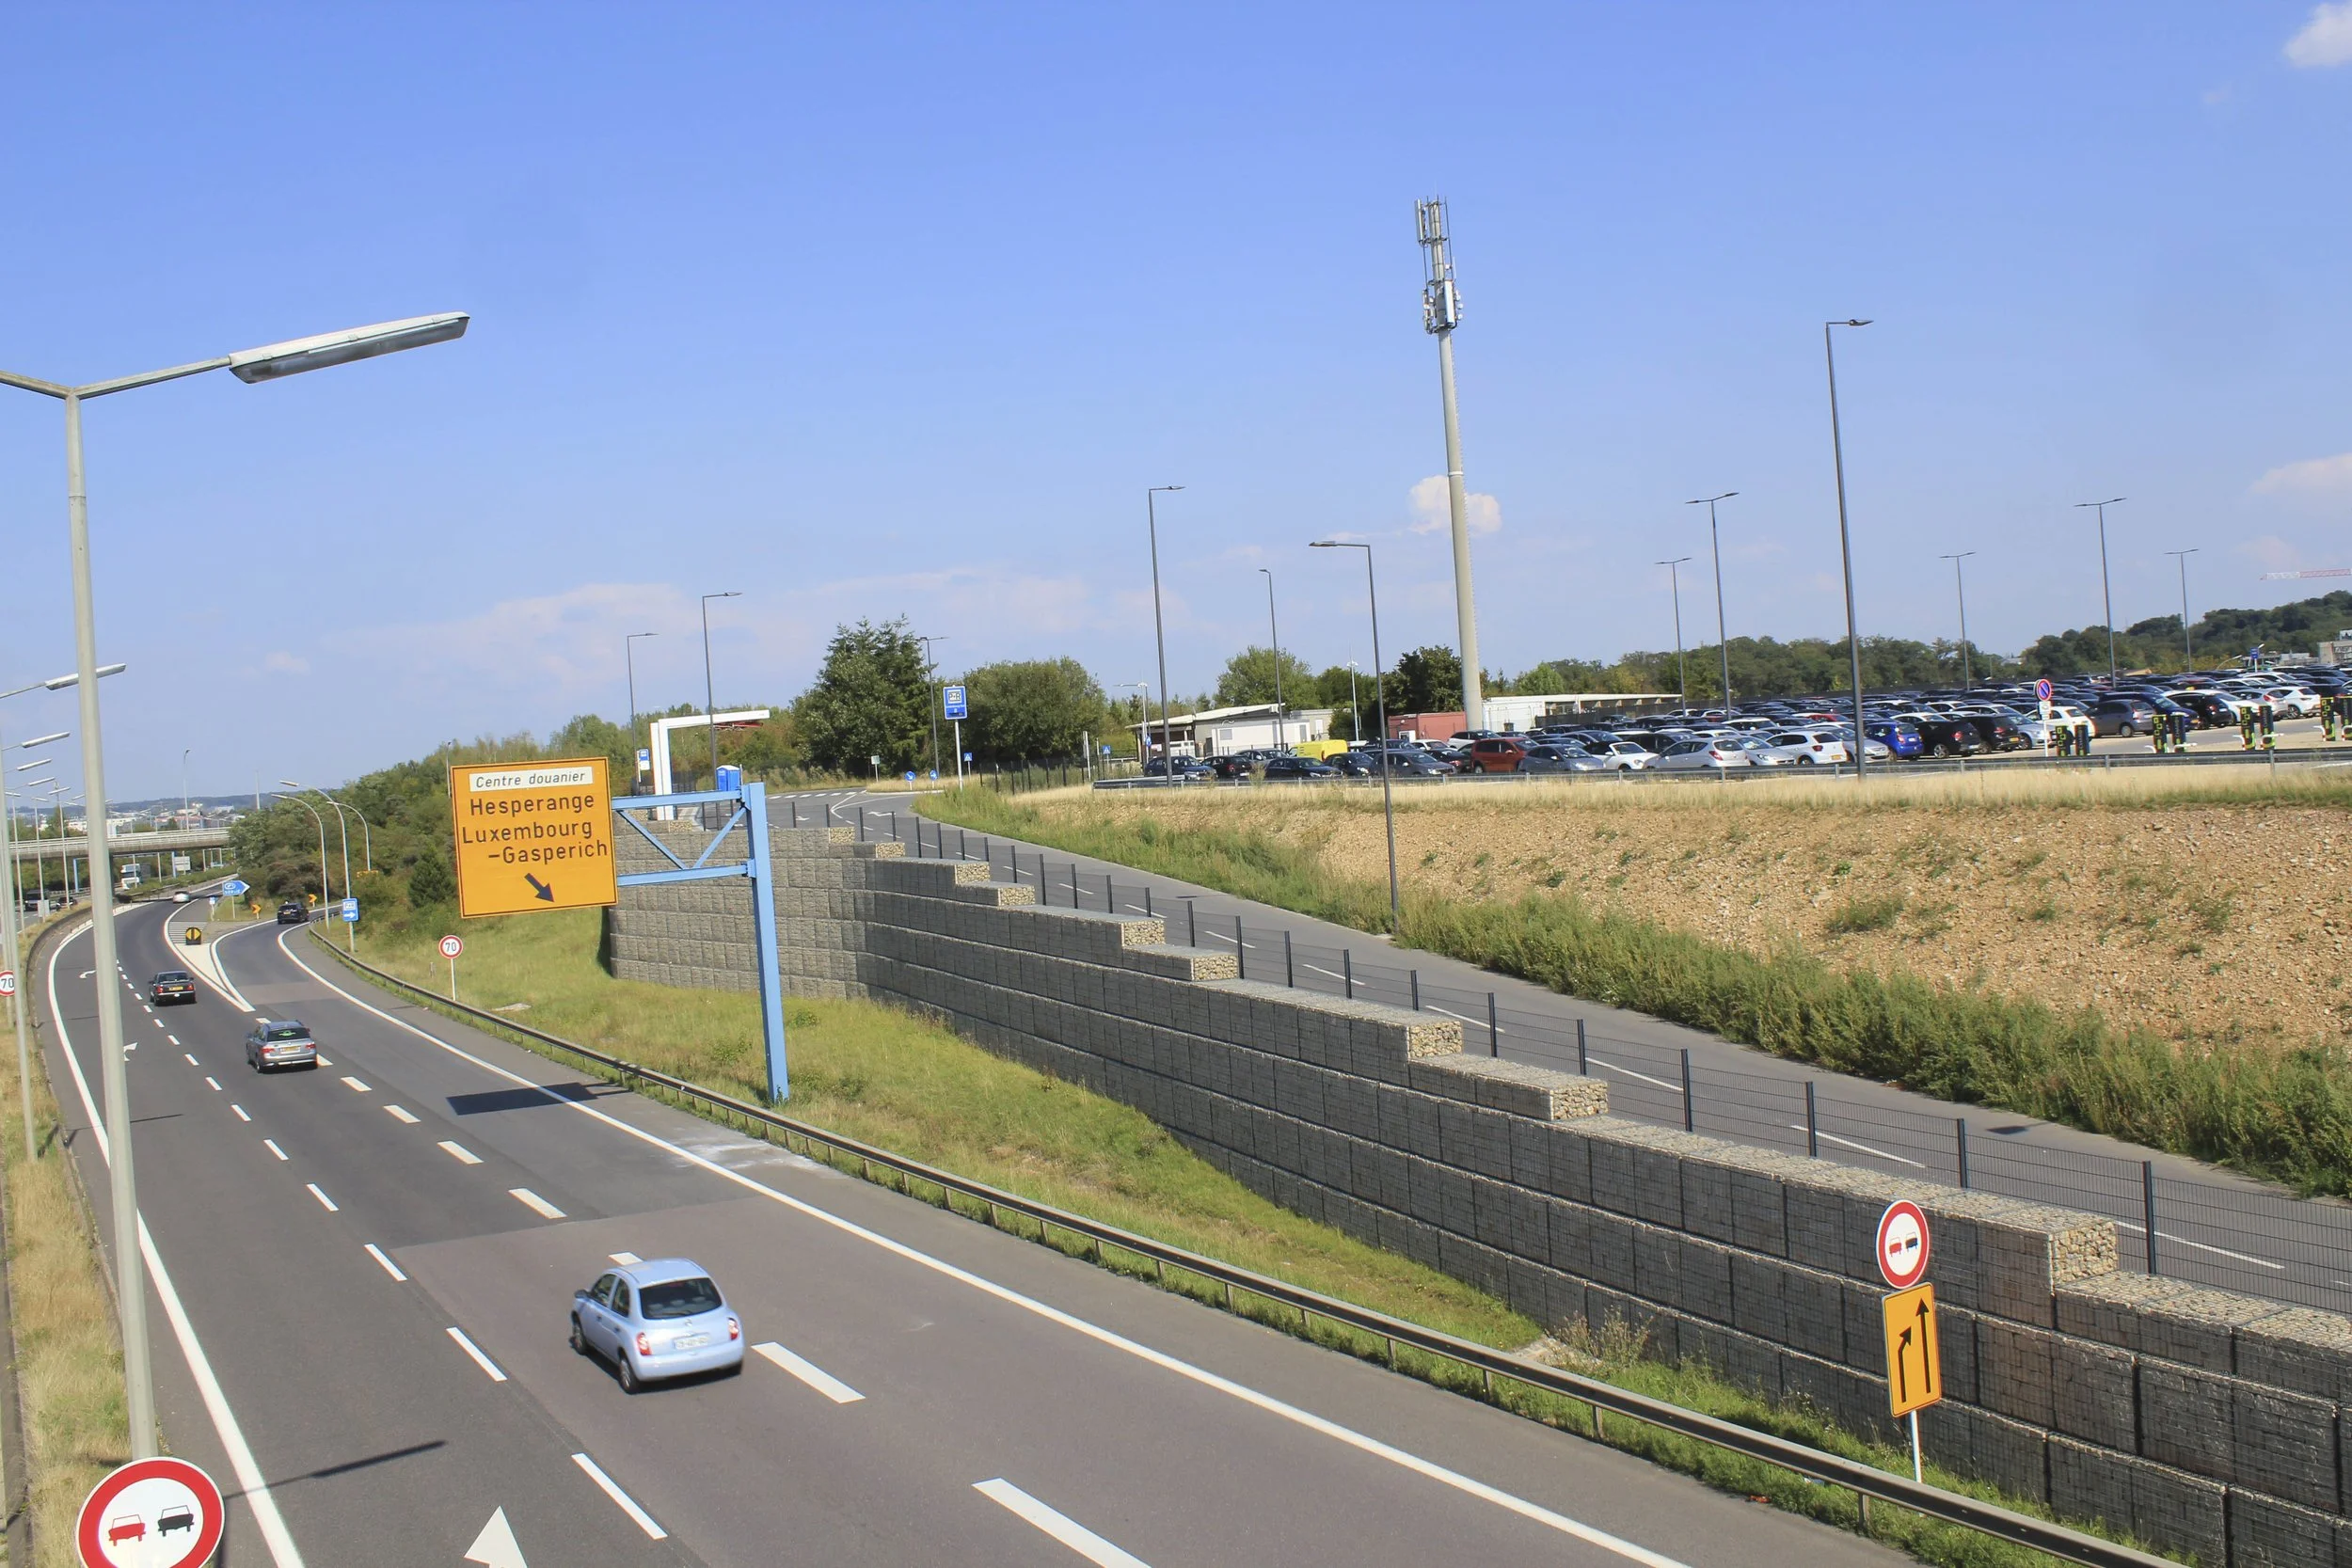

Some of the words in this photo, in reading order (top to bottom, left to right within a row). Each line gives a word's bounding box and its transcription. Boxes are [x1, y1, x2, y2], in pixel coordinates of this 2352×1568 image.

[475, 775, 521, 788] Centre
[528, 771, 585, 785] douanier
[469, 795, 594, 816] Hesperange
[462, 821, 592, 844] Luxembourg
[445, 942, 456, 952] 70
[1, 977, 14, 989] 70
